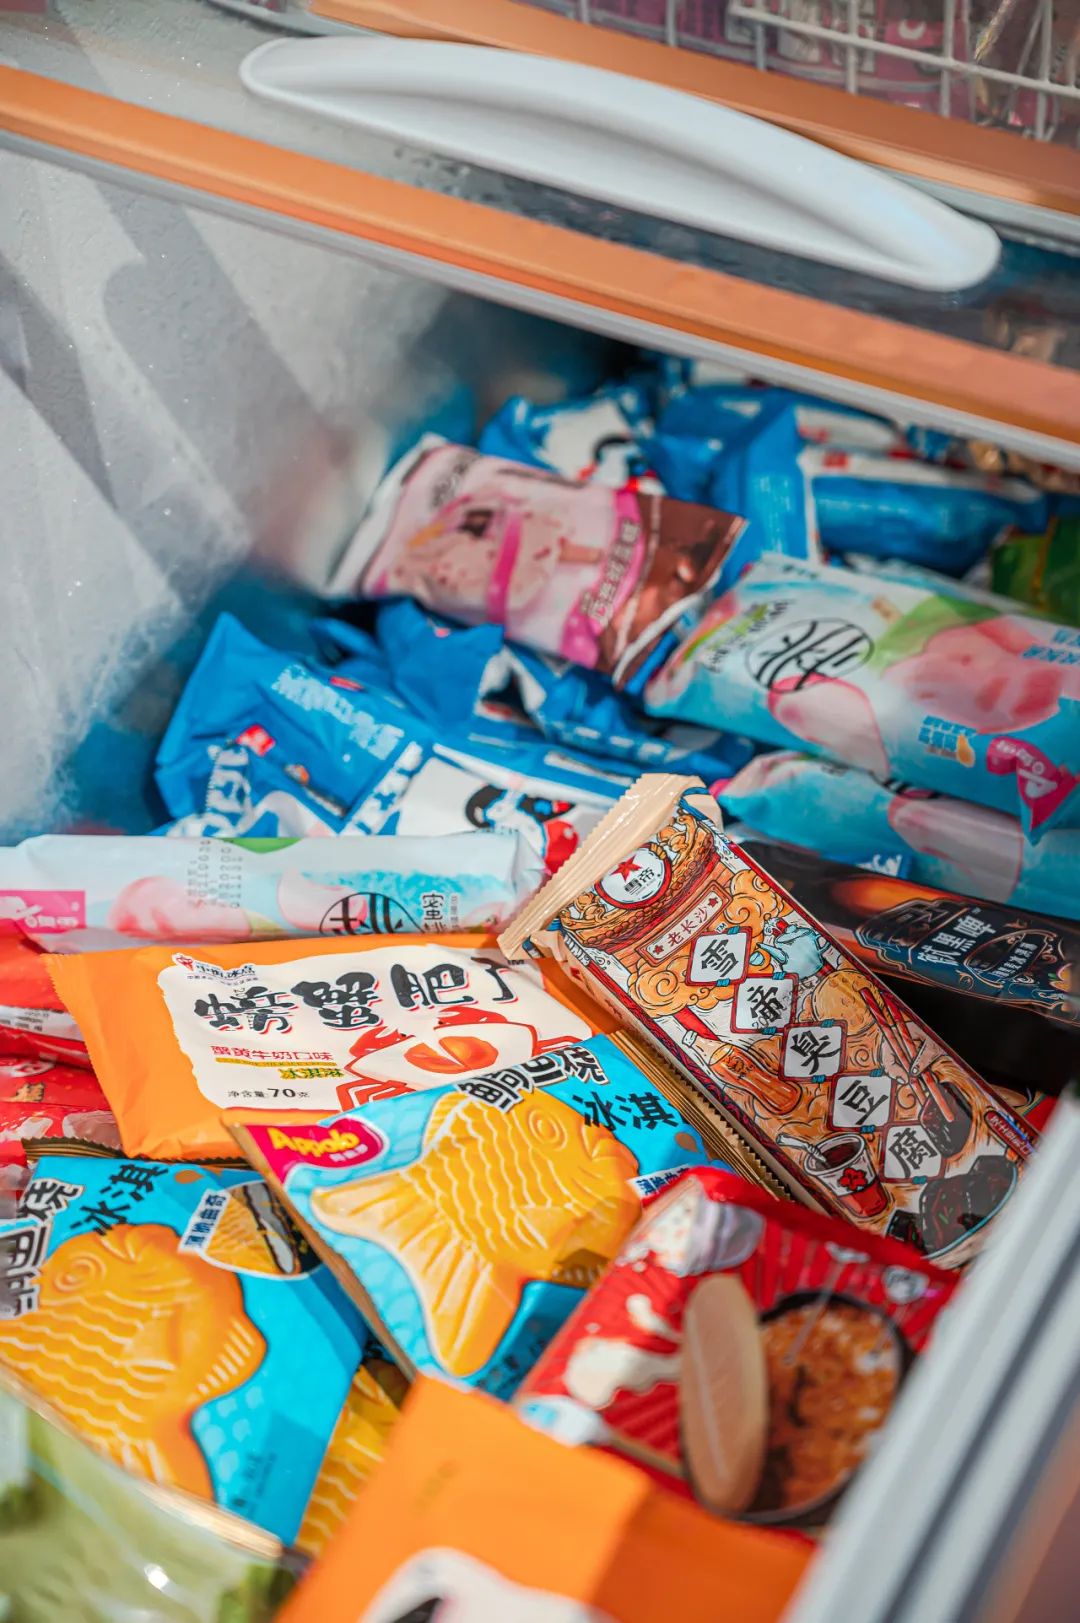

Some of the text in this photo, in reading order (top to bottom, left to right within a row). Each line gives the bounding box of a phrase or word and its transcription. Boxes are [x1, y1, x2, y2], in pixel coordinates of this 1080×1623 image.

[667, 905, 710, 946] 老长沙
[195, 957, 519, 1034] 螃蟹肥了
[210, 1046, 334, 1062] 蟹黄牛奶口味
[278, 1068, 345, 1080] 冰淇淋
[572, 1091, 691, 1132] 冰淇
